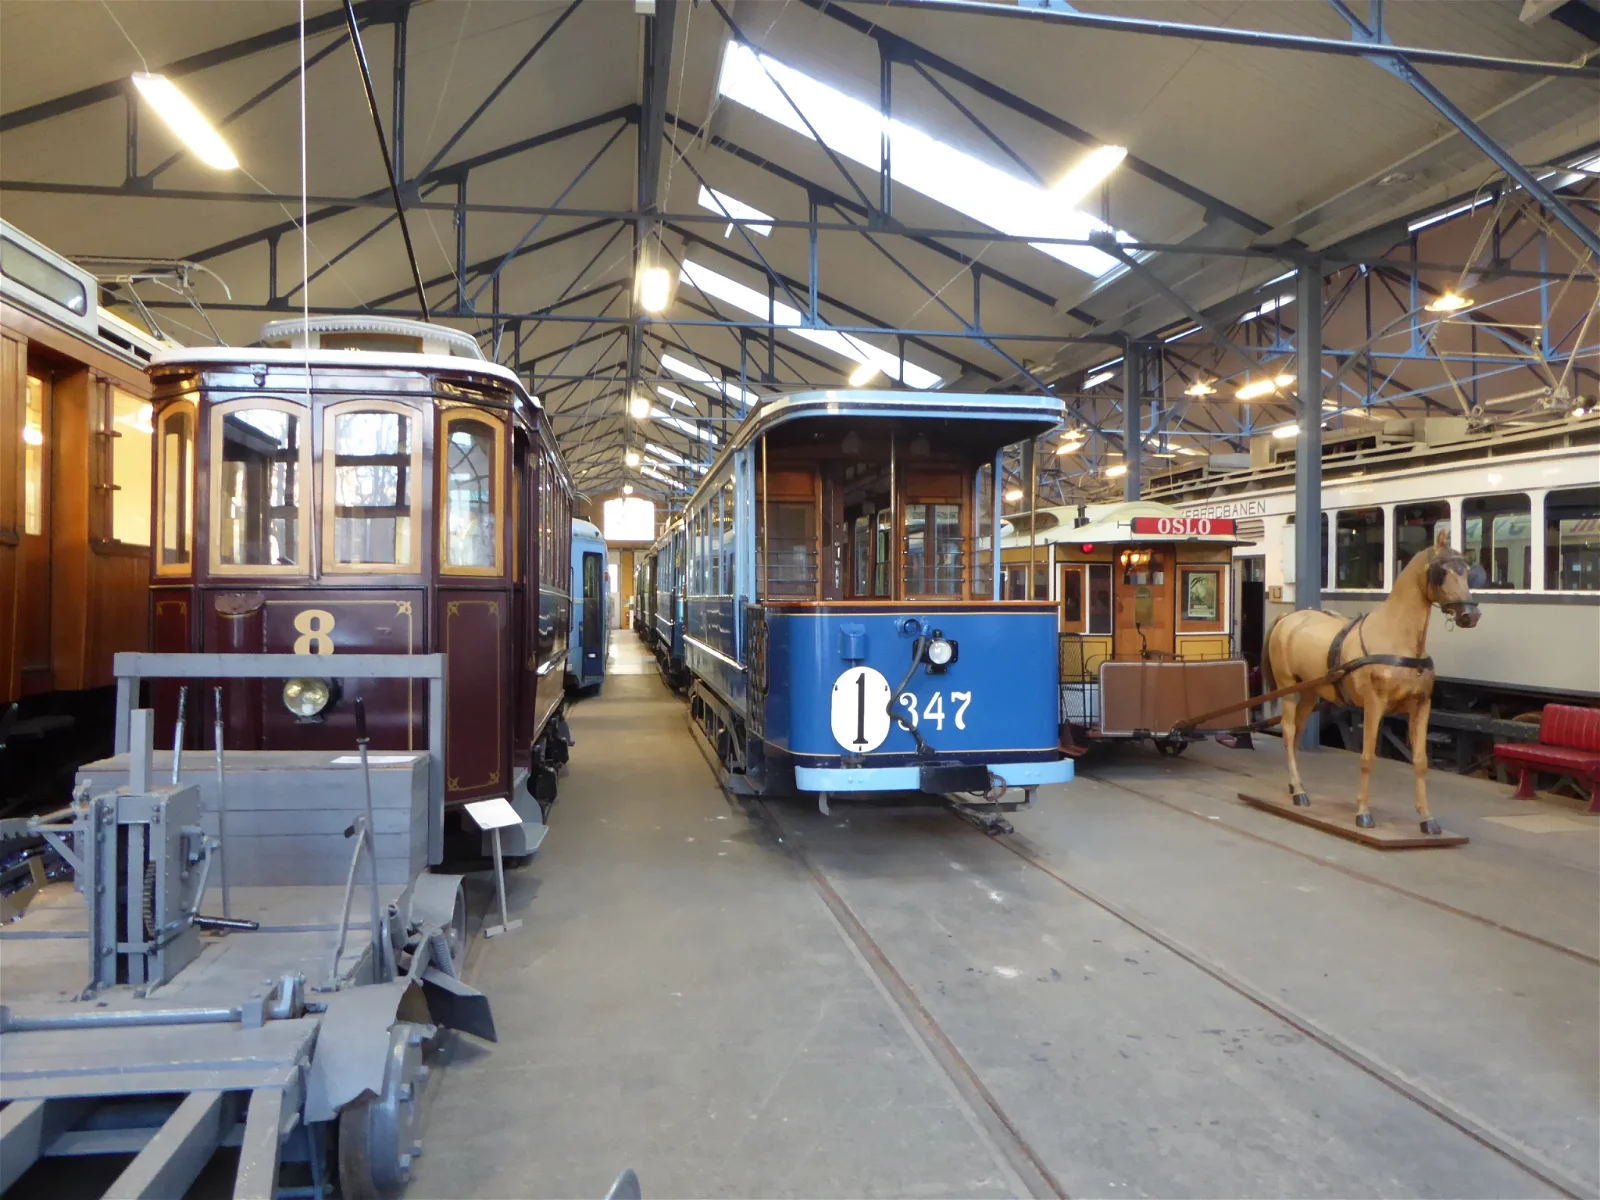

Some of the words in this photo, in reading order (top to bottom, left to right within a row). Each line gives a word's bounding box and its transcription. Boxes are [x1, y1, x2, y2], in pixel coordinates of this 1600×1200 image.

[1157, 517, 1211, 534] OSLO
[1181, 500, 1265, 519] EBERGBANEN
[294, 609, 335, 655] 8
[852, 672, 868, 744] 1
[897, 691, 972, 731] 347
